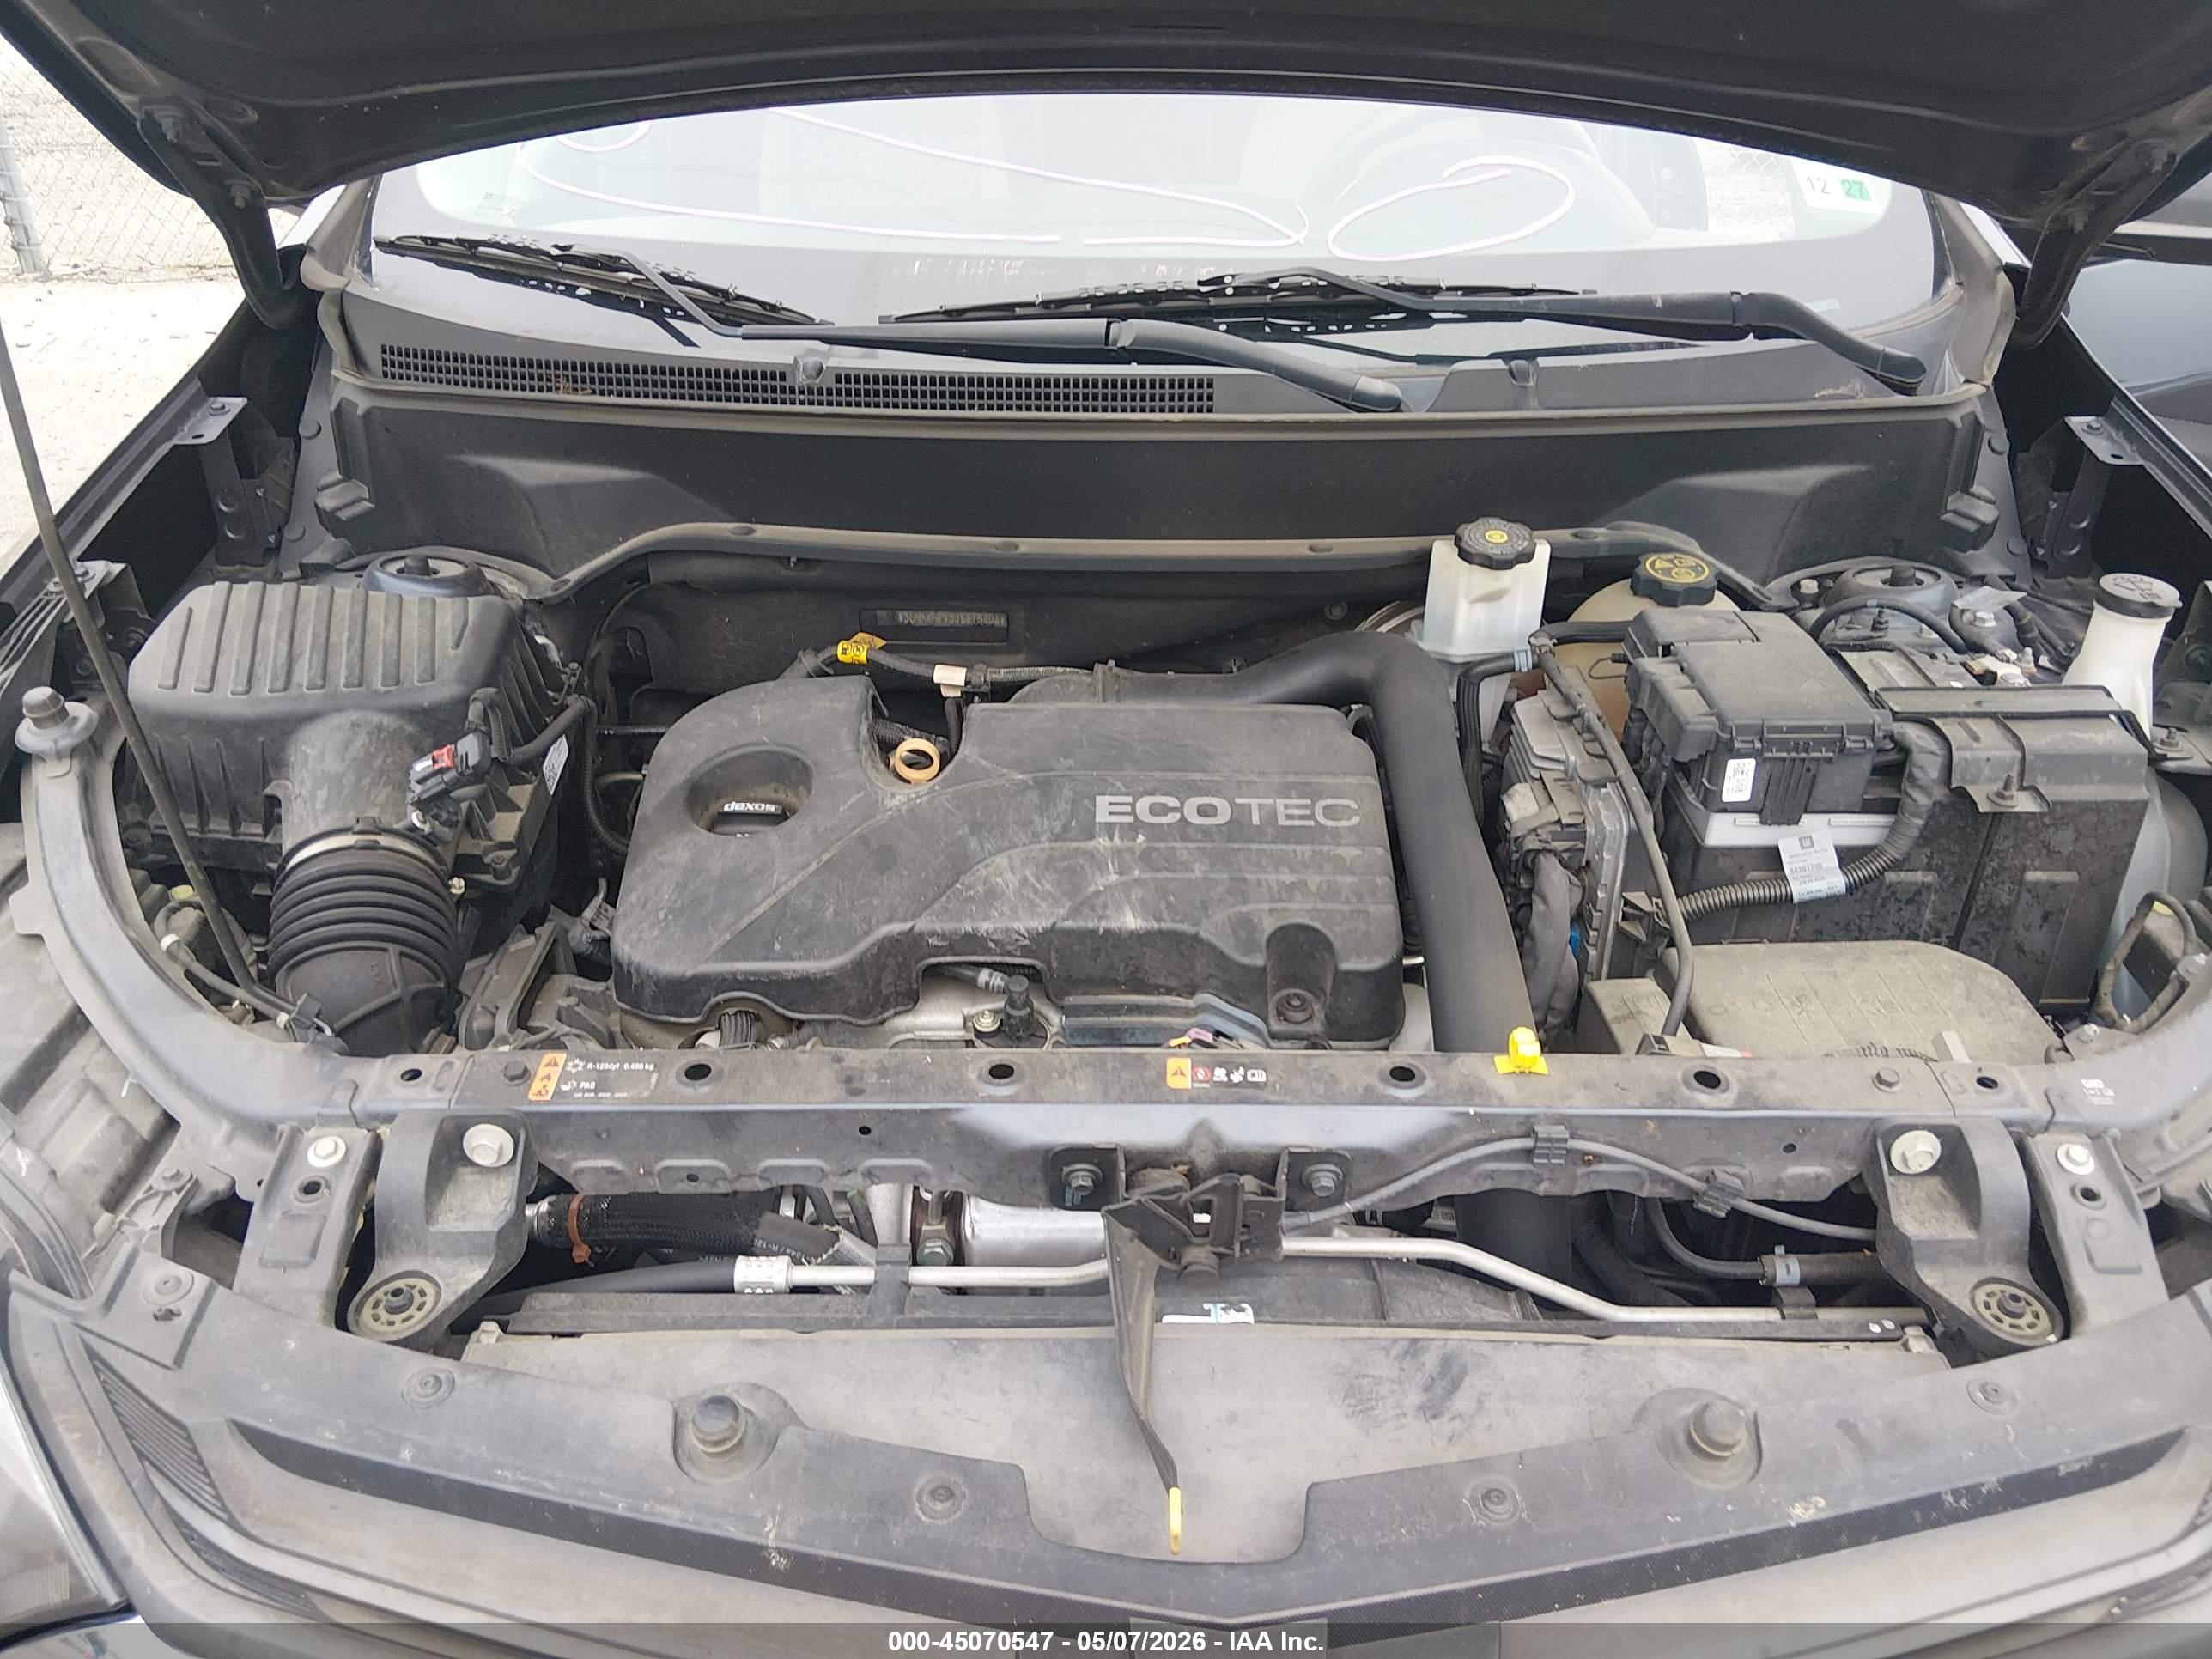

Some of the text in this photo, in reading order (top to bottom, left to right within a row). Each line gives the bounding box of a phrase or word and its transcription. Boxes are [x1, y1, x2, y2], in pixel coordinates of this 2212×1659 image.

[1806, 176, 1866, 198] 12 27
[723, 801, 776, 812] dexos
[1095, 794, 1361, 828] ECOTEC
